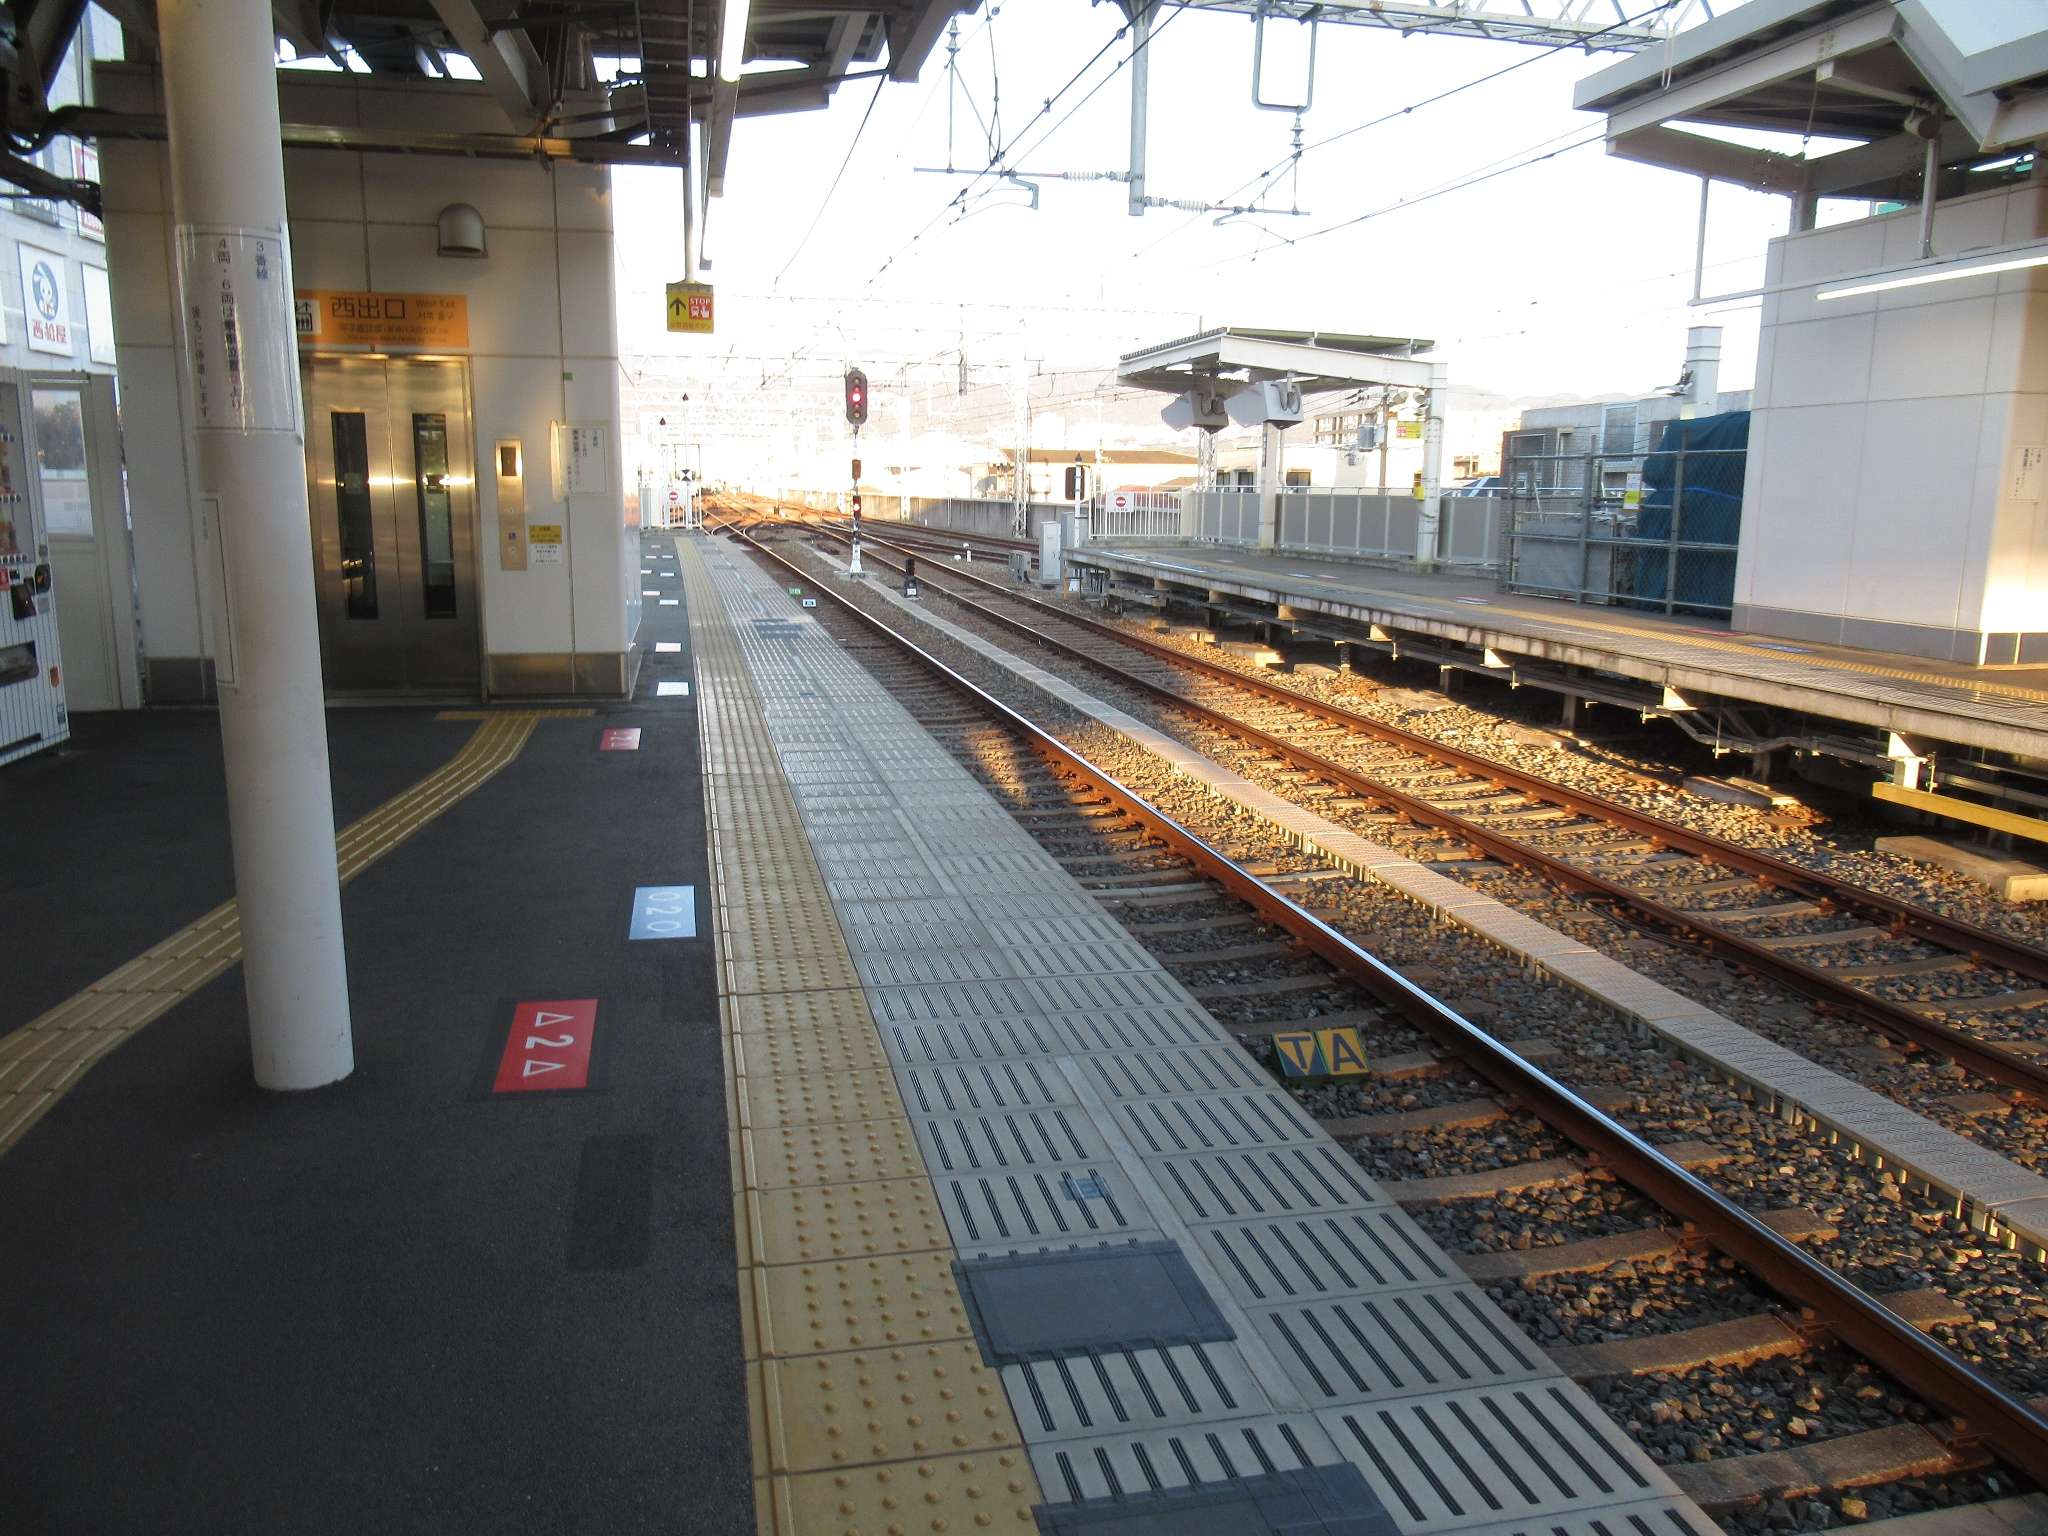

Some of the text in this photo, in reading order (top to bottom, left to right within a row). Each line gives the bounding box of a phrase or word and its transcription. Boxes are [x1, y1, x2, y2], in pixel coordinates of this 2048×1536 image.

[331, 297, 406, 320] 西出口
[32, 320, 68, 344] 西松屋
